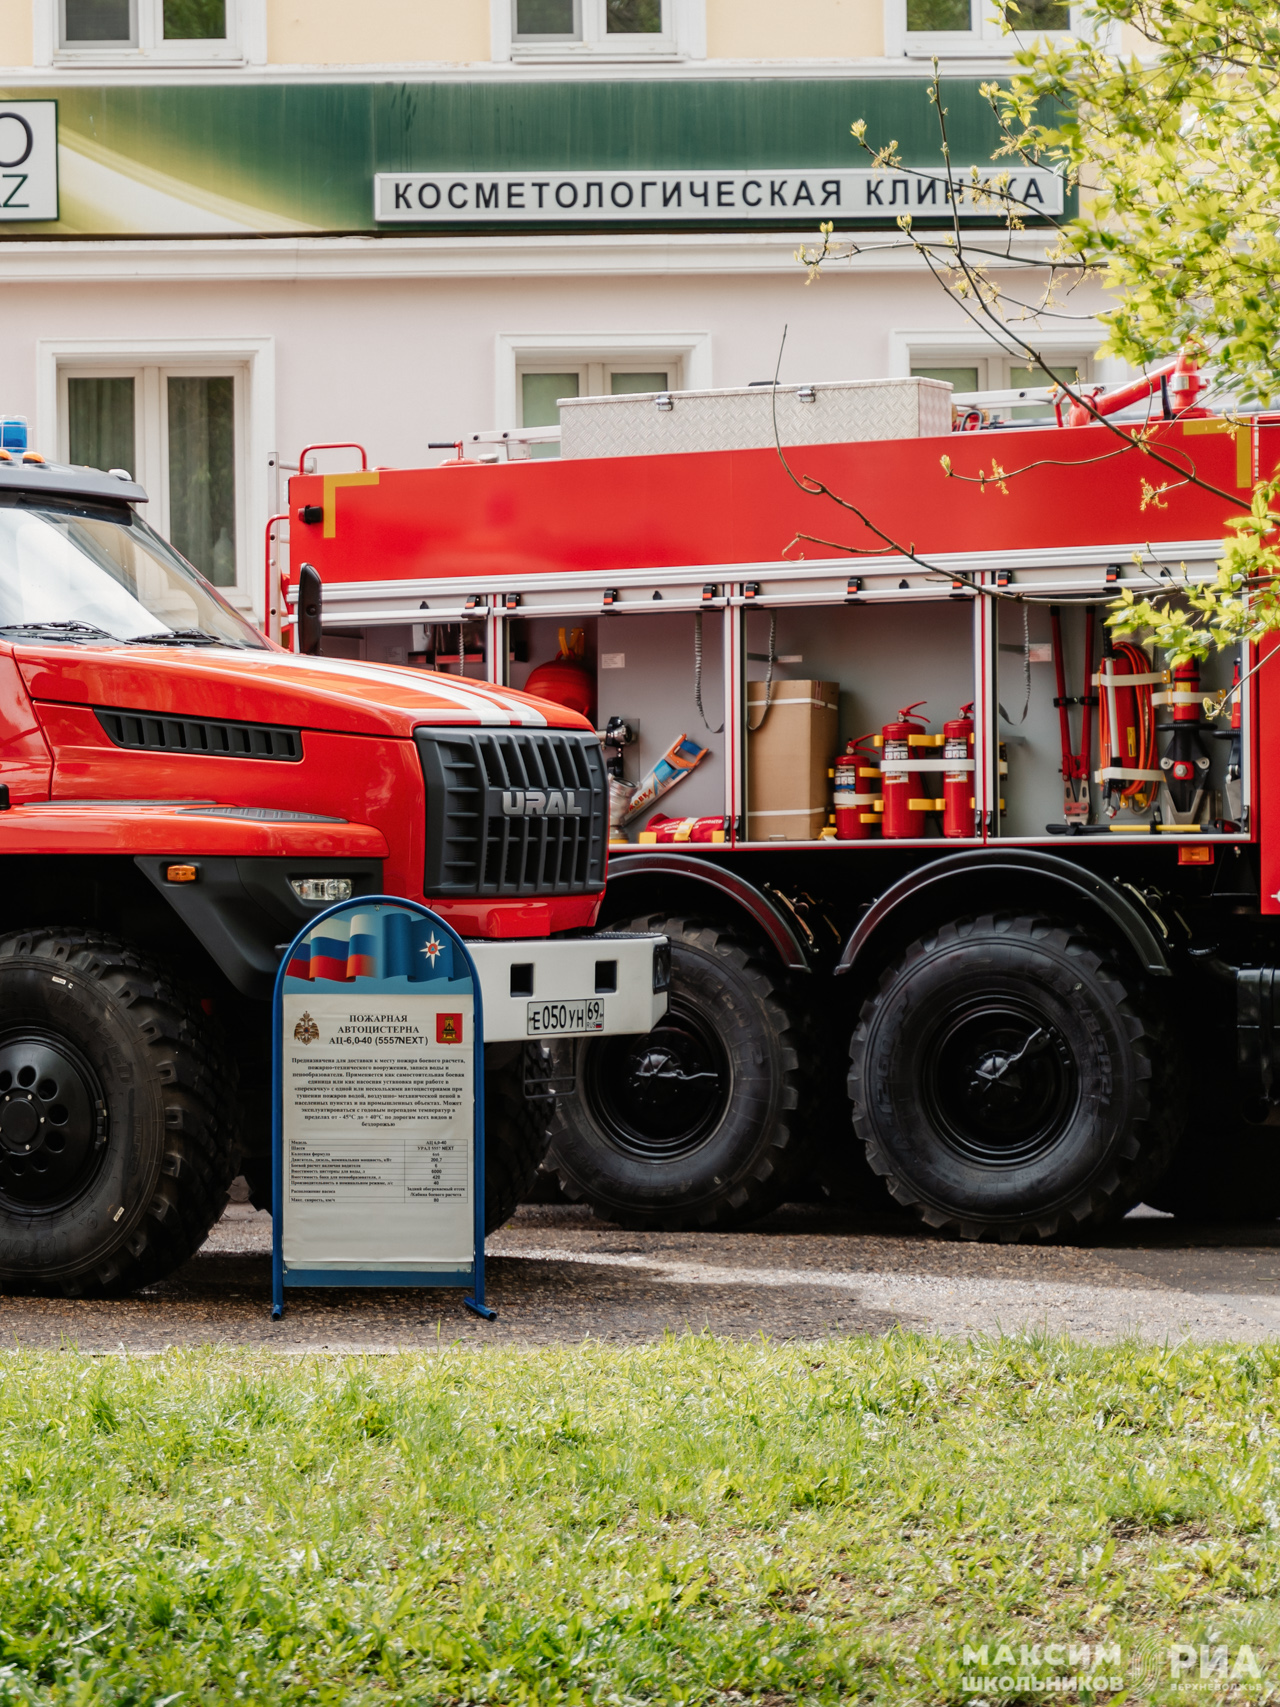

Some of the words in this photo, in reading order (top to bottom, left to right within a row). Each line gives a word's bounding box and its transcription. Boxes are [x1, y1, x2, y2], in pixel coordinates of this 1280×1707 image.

[395, 180, 842, 209] КОСМЕТОЛОГИЧЕСКАЯ
[502, 791, 582, 815] URAL
[587, 1001, 600, 1020] 69
[338, 1025, 420, 1034] АВТОЦИСТЕРНА
[329, 1037, 372, 1046] АЦ-6,0-40
